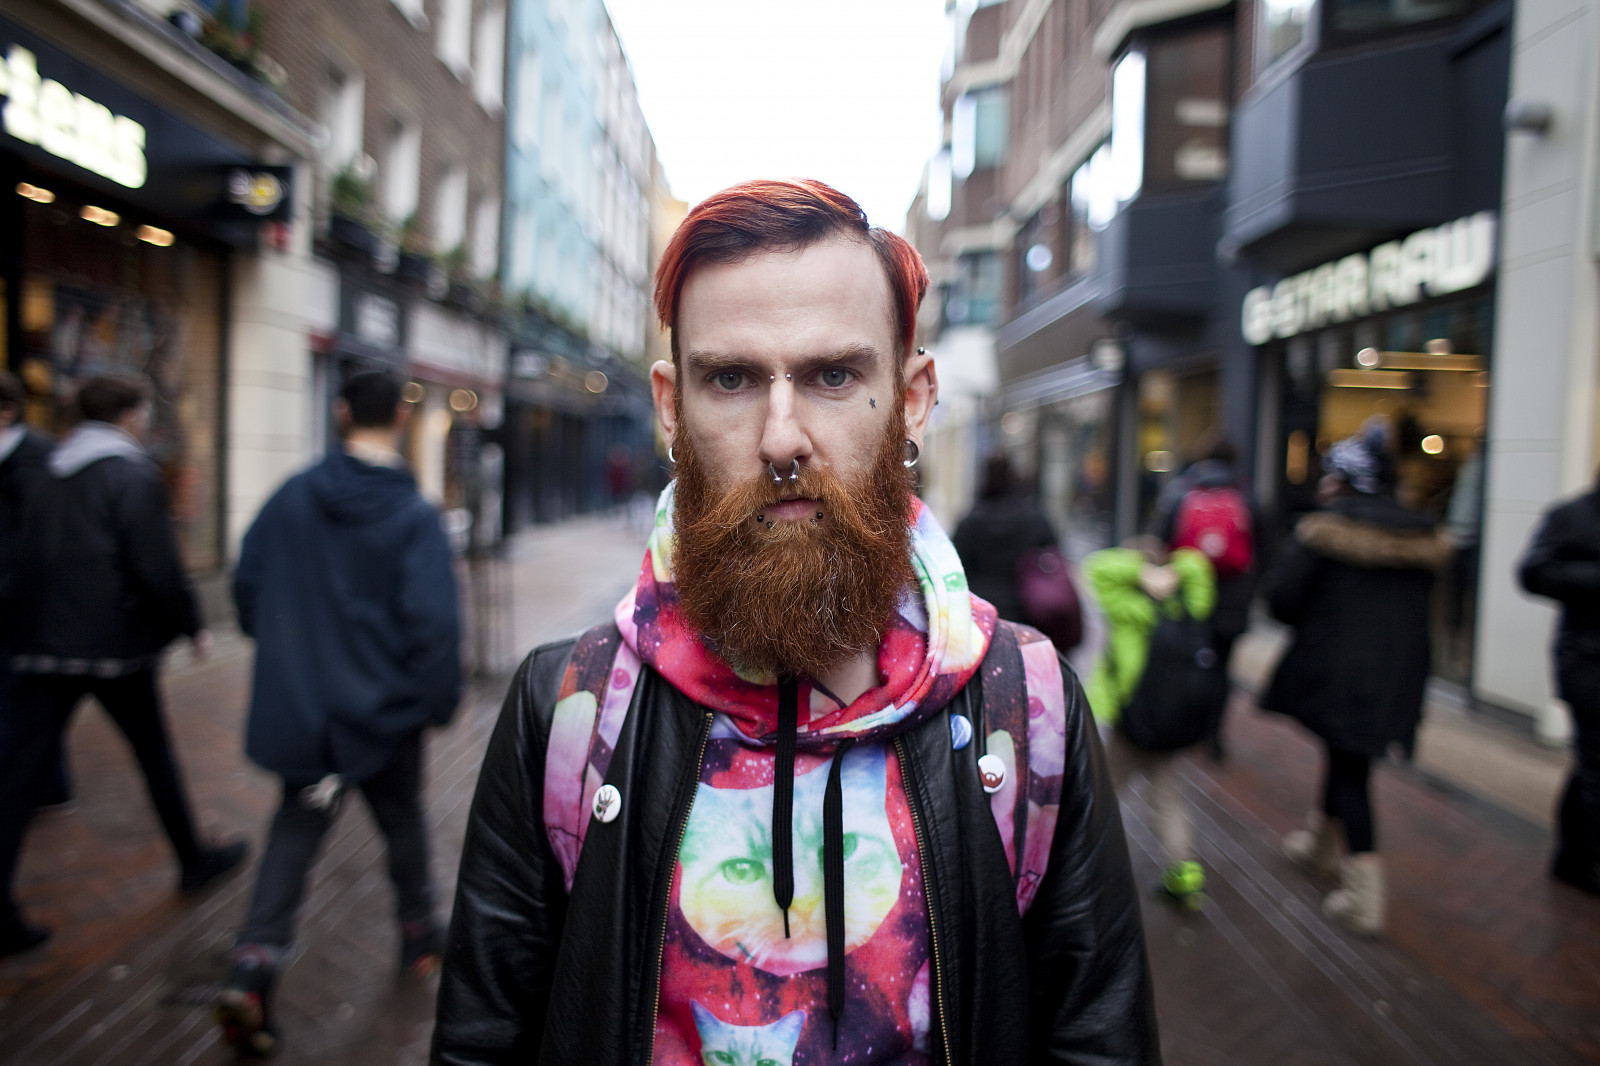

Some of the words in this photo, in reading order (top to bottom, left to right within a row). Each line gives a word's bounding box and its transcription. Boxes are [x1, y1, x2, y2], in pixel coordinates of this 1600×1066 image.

[0, 43, 148, 189] tens
[1242, 253, 1369, 345] G-STAR
[1370, 210, 1496, 311] RAW
